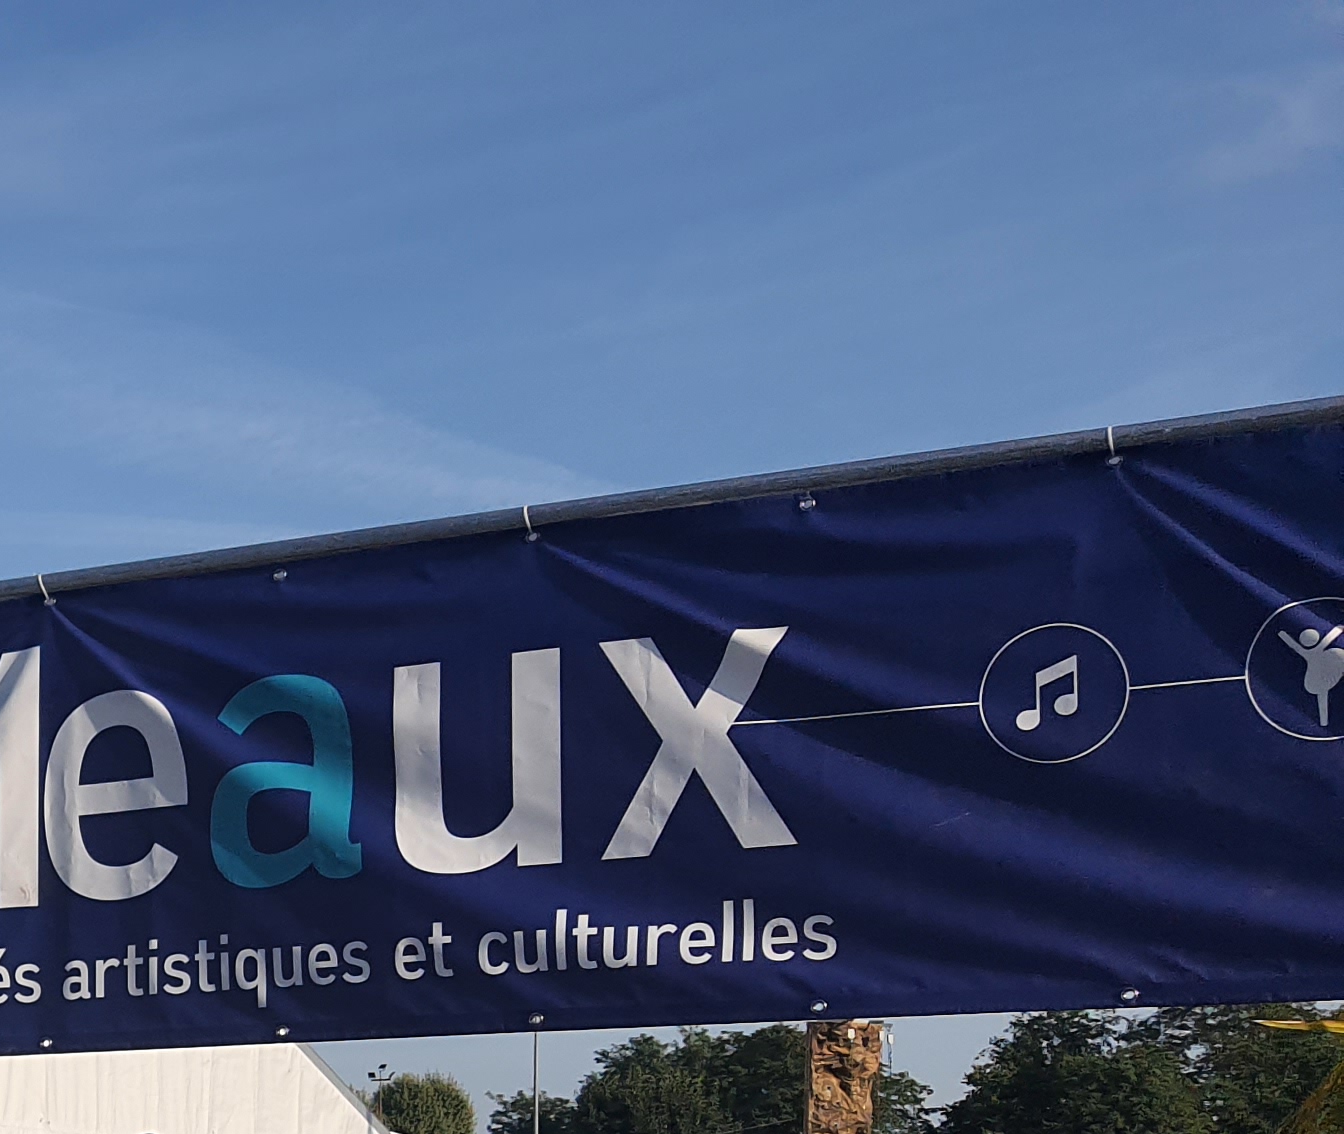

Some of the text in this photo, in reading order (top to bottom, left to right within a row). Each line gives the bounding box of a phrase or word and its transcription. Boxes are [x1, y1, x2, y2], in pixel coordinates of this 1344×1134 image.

[62, 933, 372, 1009] artistiques
[394, 921, 453, 981] et
[477, 898, 838, 975] culturelles
